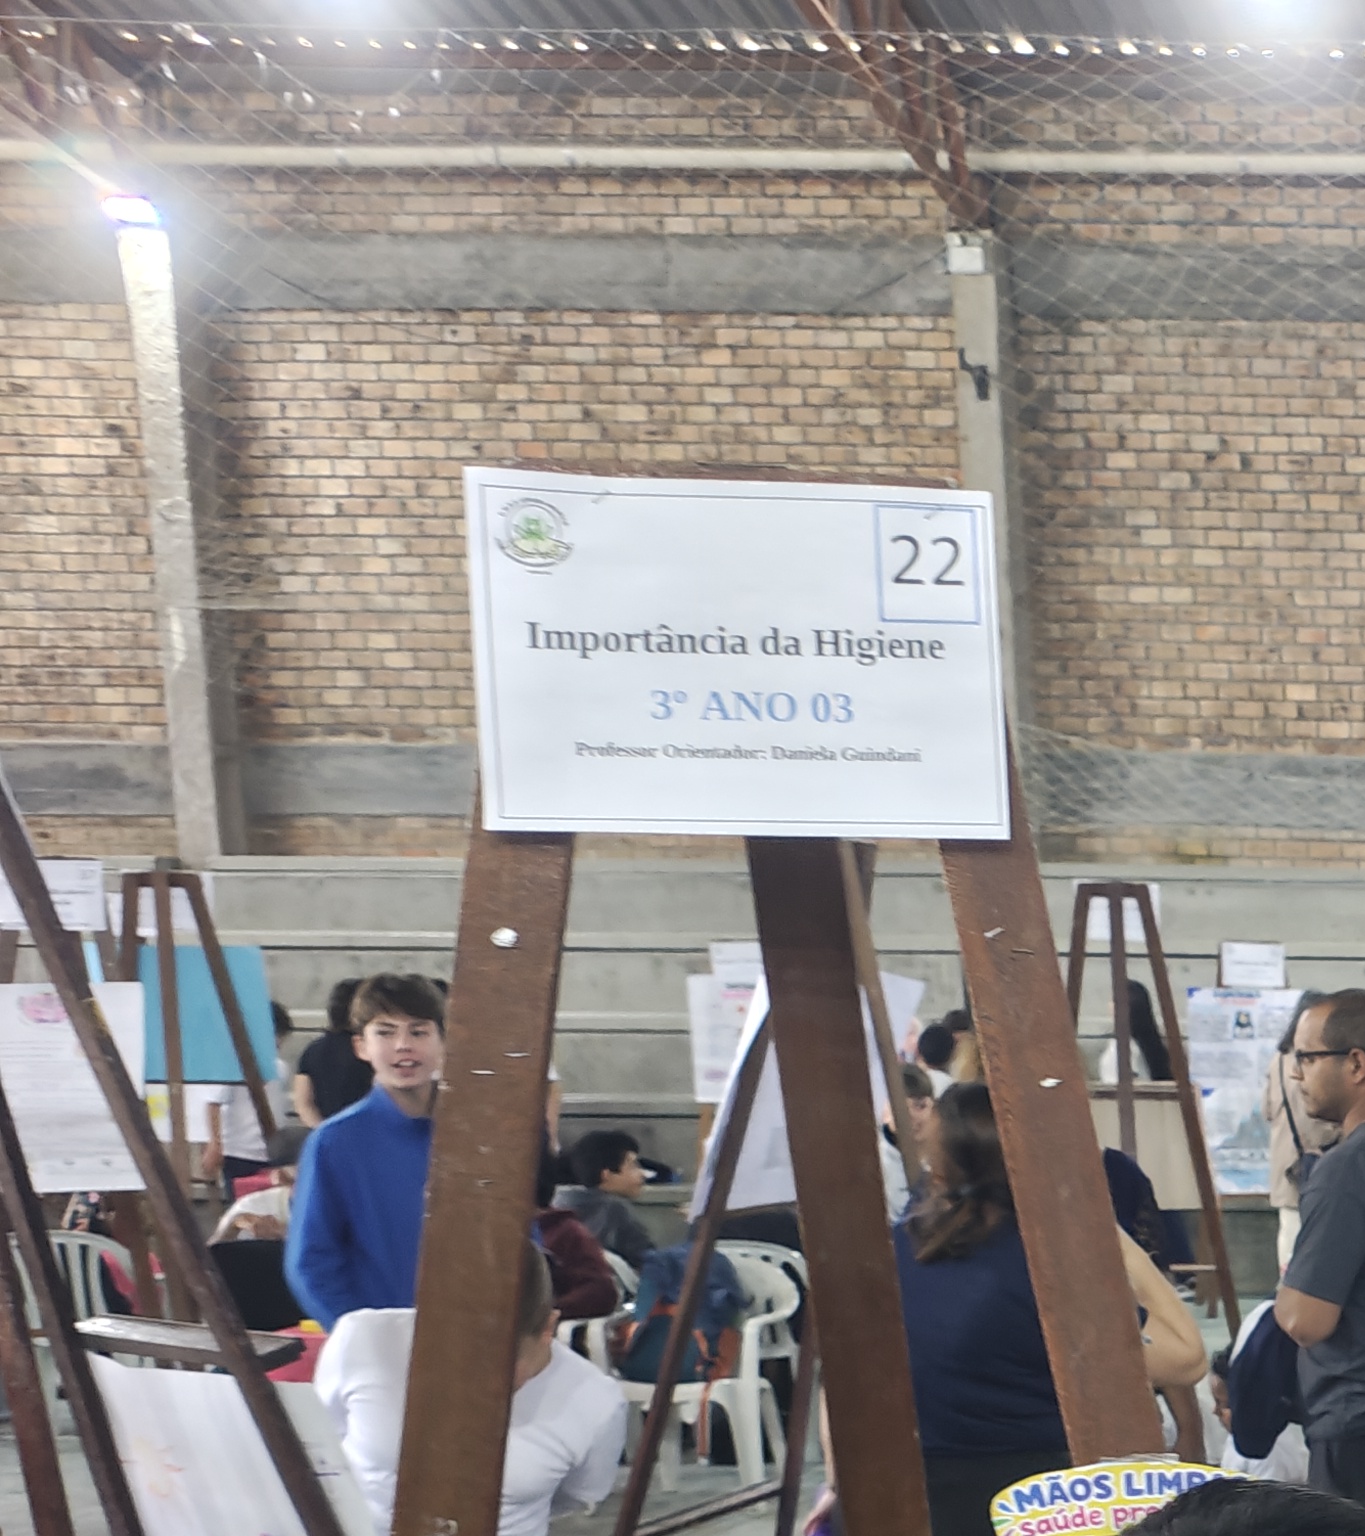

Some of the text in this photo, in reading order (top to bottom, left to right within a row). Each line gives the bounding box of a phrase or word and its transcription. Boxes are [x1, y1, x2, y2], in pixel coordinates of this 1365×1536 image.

[889, 534, 965, 587] 22
[525, 621, 946, 667] Importância da Higiene
[699, 690, 798, 724] ANO
[811, 692, 855, 724] 03
[574, 740, 659, 759] Professor
[662, 742, 767, 761] Orientador:
[769, 744, 838, 762] Daniela
[1010, 1473, 1113, 1514] MÃOS
